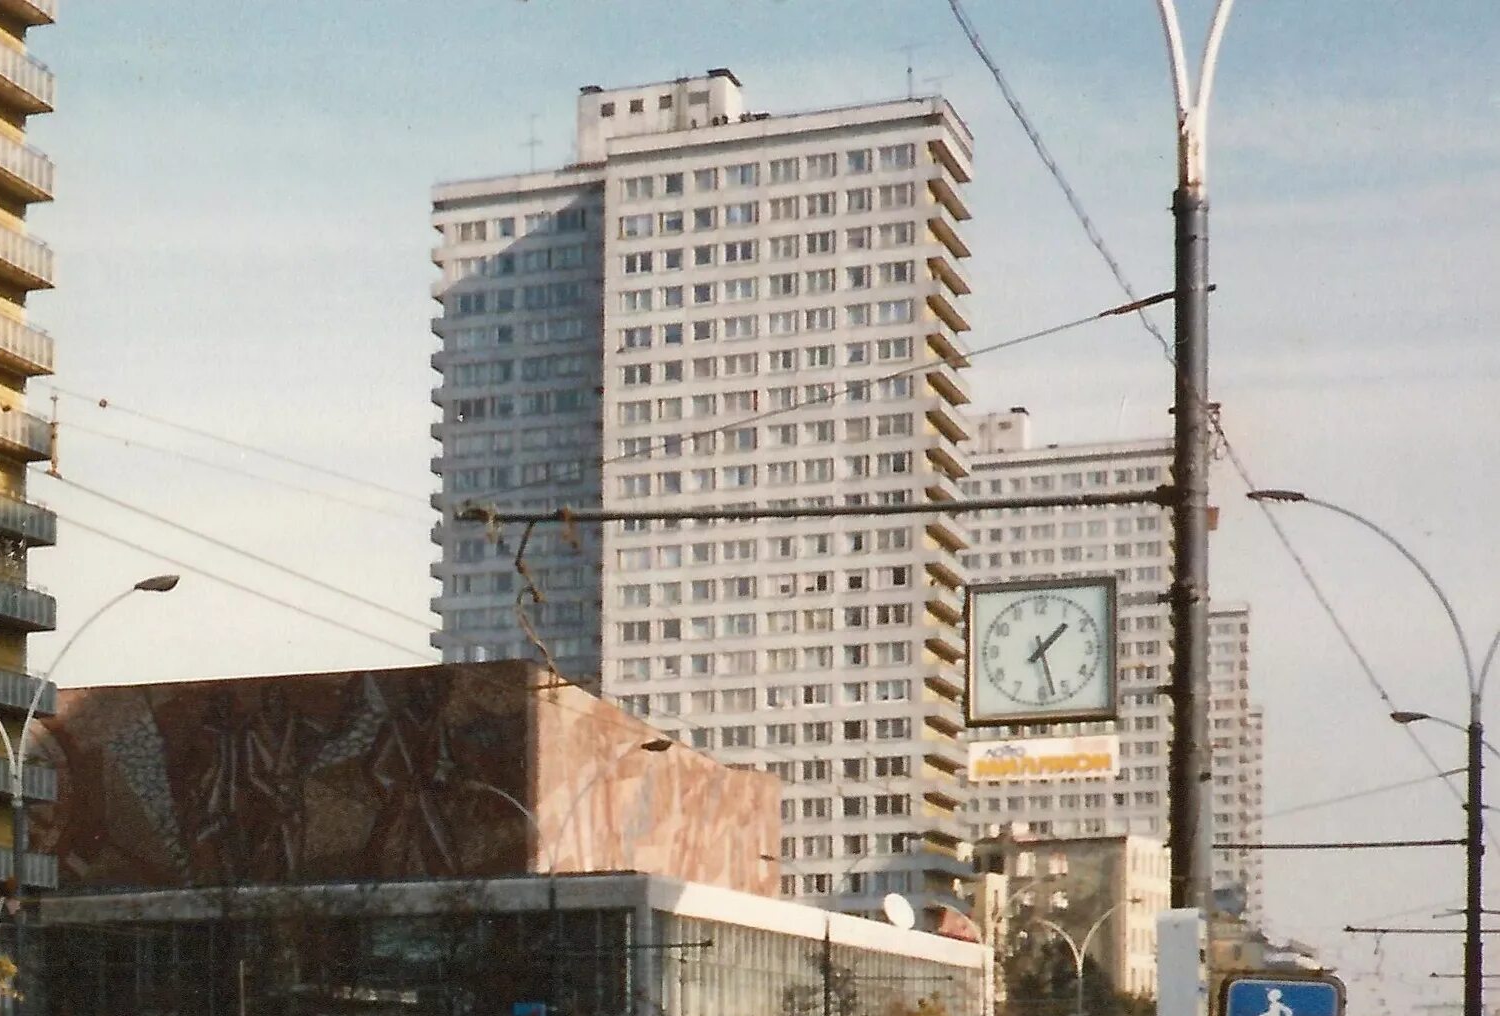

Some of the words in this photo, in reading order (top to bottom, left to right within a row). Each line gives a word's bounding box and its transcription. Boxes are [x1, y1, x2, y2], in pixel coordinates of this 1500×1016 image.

[1033, 600, 1047, 615] 12
[996, 622, 1009, 637] 10
[1079, 618, 1091, 632] 2
[1084, 640, 1093, 655] 3
[1077, 663, 1087, 676] 4
[1013, 680, 1022, 695] 7
[1060, 680, 1070, 694] 5
